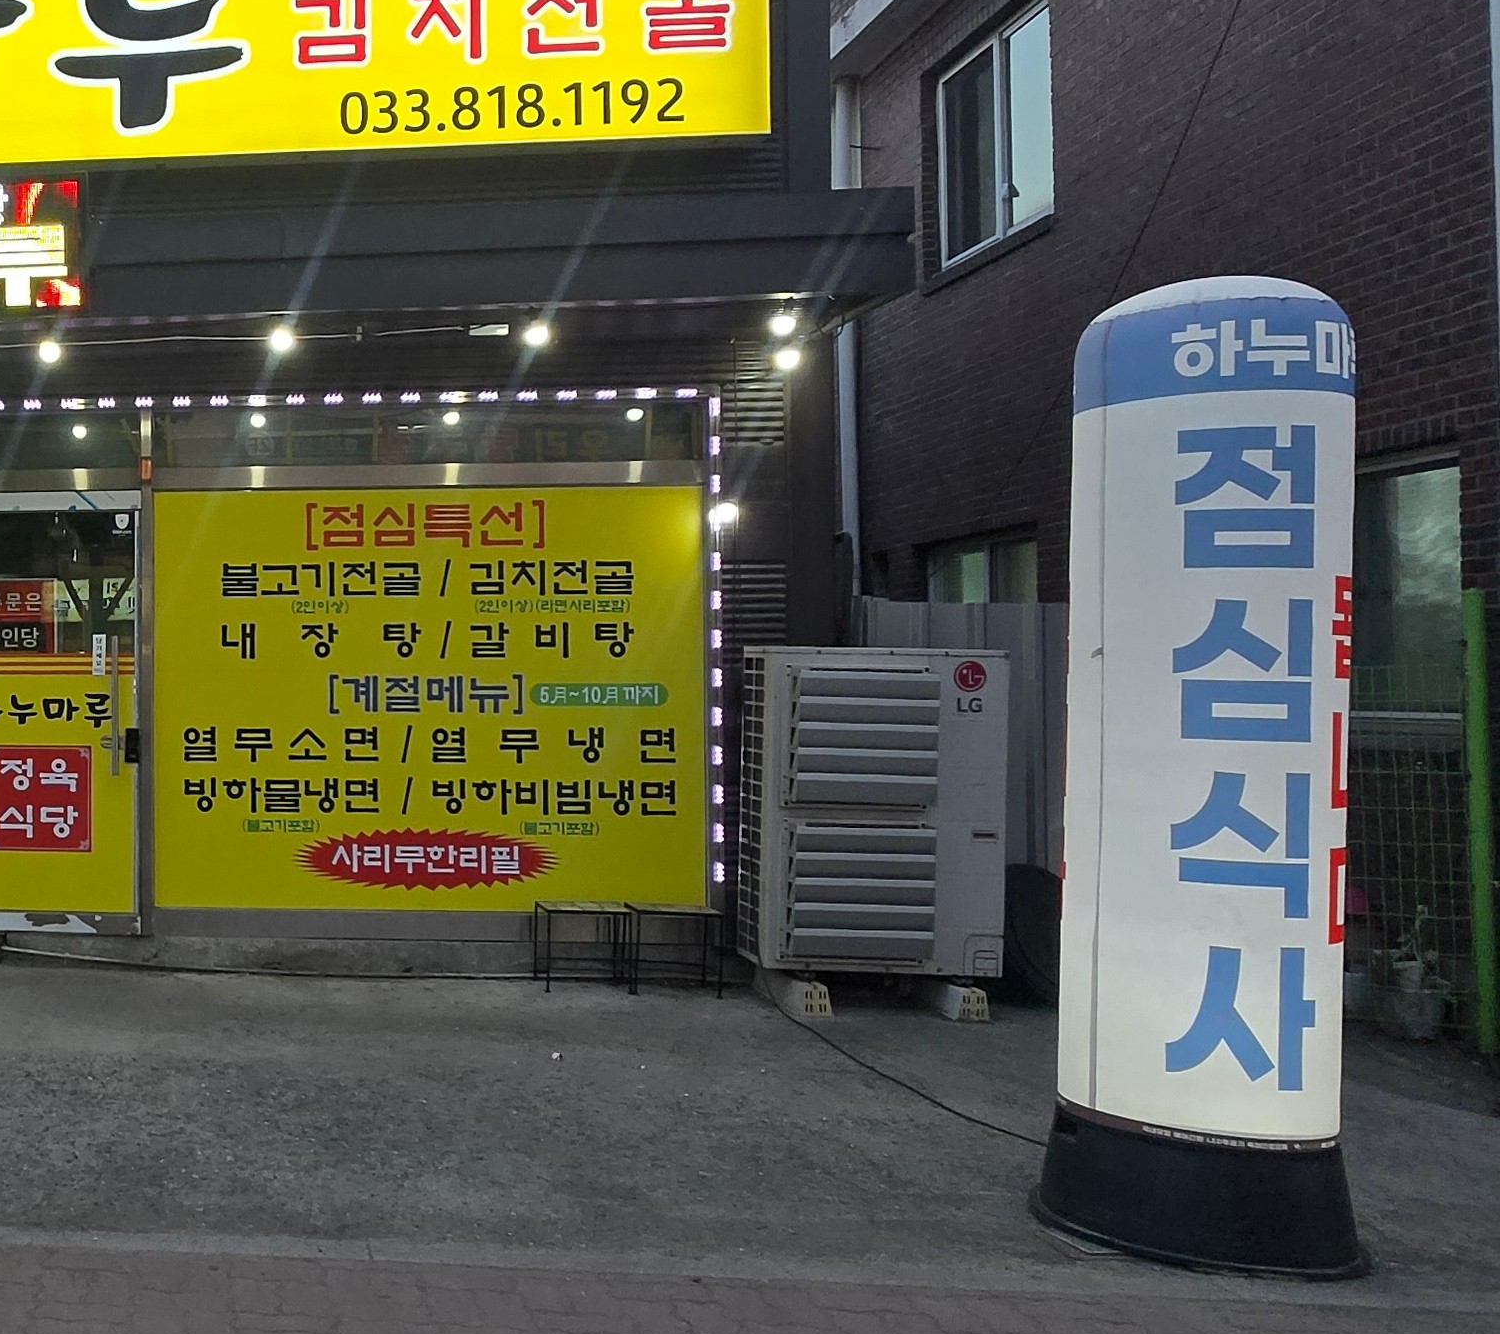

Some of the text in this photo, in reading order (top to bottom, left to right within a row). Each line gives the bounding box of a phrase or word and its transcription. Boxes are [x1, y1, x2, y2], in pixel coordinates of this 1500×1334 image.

[339, 77, 686, 135] 033.818.1192
[1171, 318, 1356, 379] 하누마
[305, 499, 546, 551] [점심특선]
[221, 560, 421, 597] 불고기전골
[469, 559, 635, 596] 김치전골
[328, 673, 524, 715] [계절메뉴]
[957, 697, 983, 713] LG
[0, 757, 79, 793] 정육
[1165, 424, 1318, 1092] 점심식사
[183, 776, 380, 814] 빙하물냉면
[431, 778, 677, 816] 빙하비빔냉면
[0, 804, 79, 839] 식당
[331, 843, 521, 875] 사리무한리필
